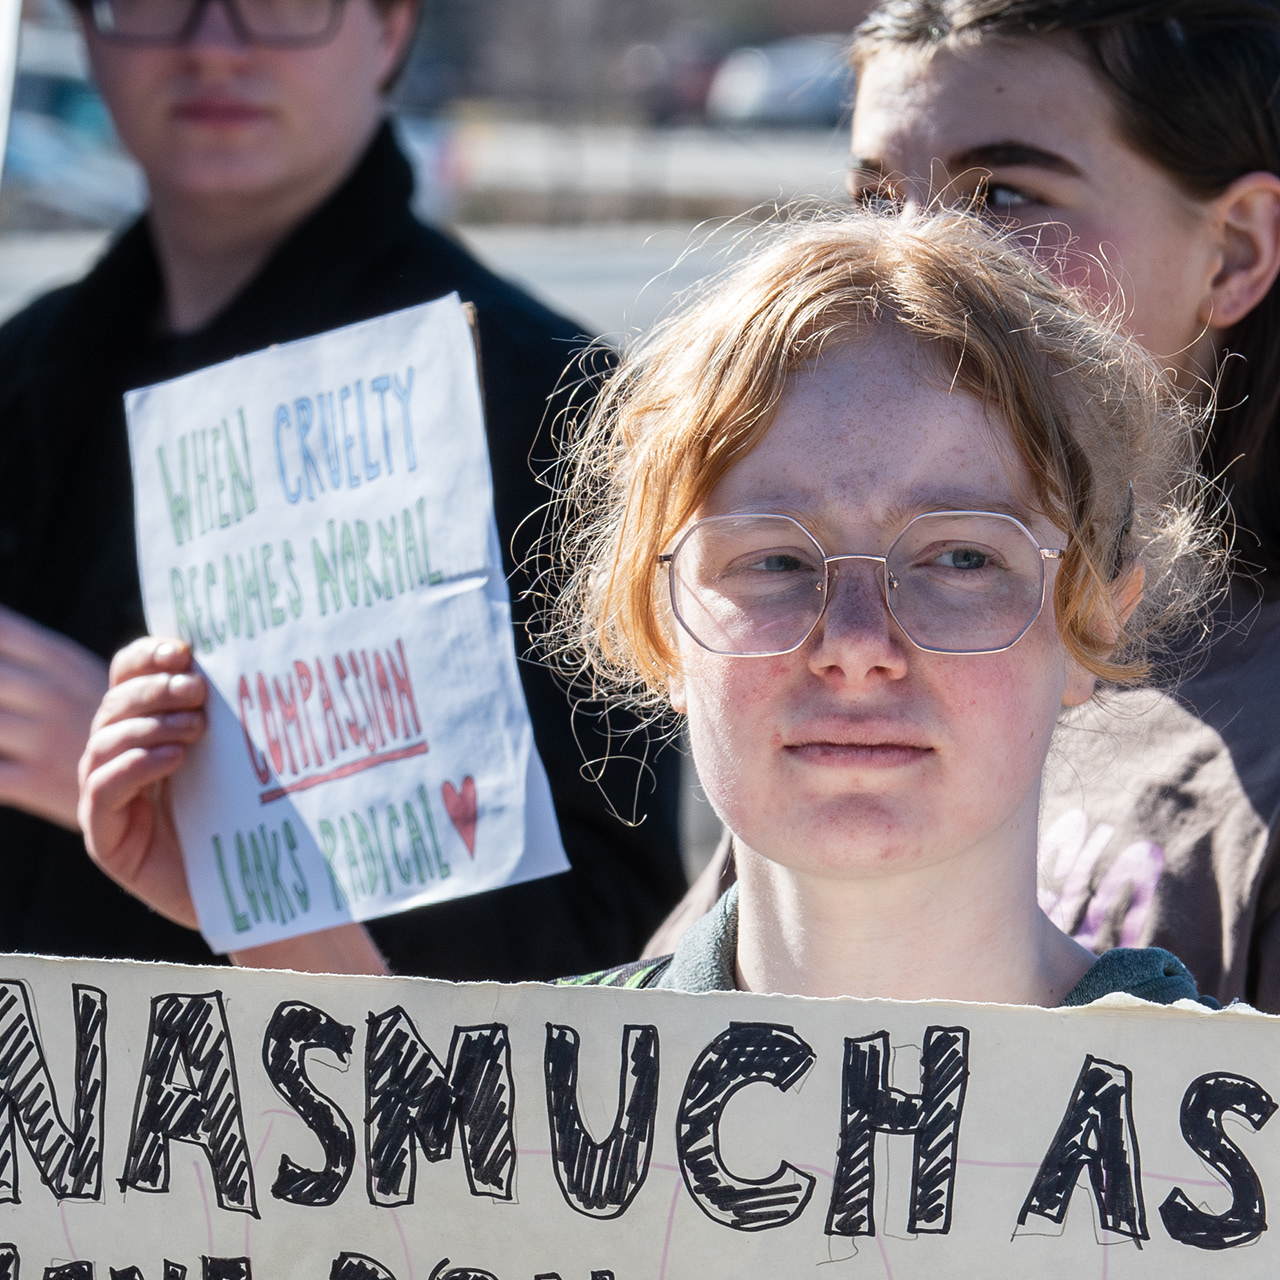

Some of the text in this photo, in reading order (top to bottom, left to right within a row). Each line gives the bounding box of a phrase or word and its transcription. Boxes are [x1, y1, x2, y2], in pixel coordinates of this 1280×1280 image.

[157, 365, 417, 548] WHEN CRUELTY
[170, 495, 443, 657] BECOMES NORMAL
[238, 636, 423, 785] COMPASSION
[210, 783, 452, 933] LOOKS RADICAL
[1016, 1054, 1279, 1250] AS
